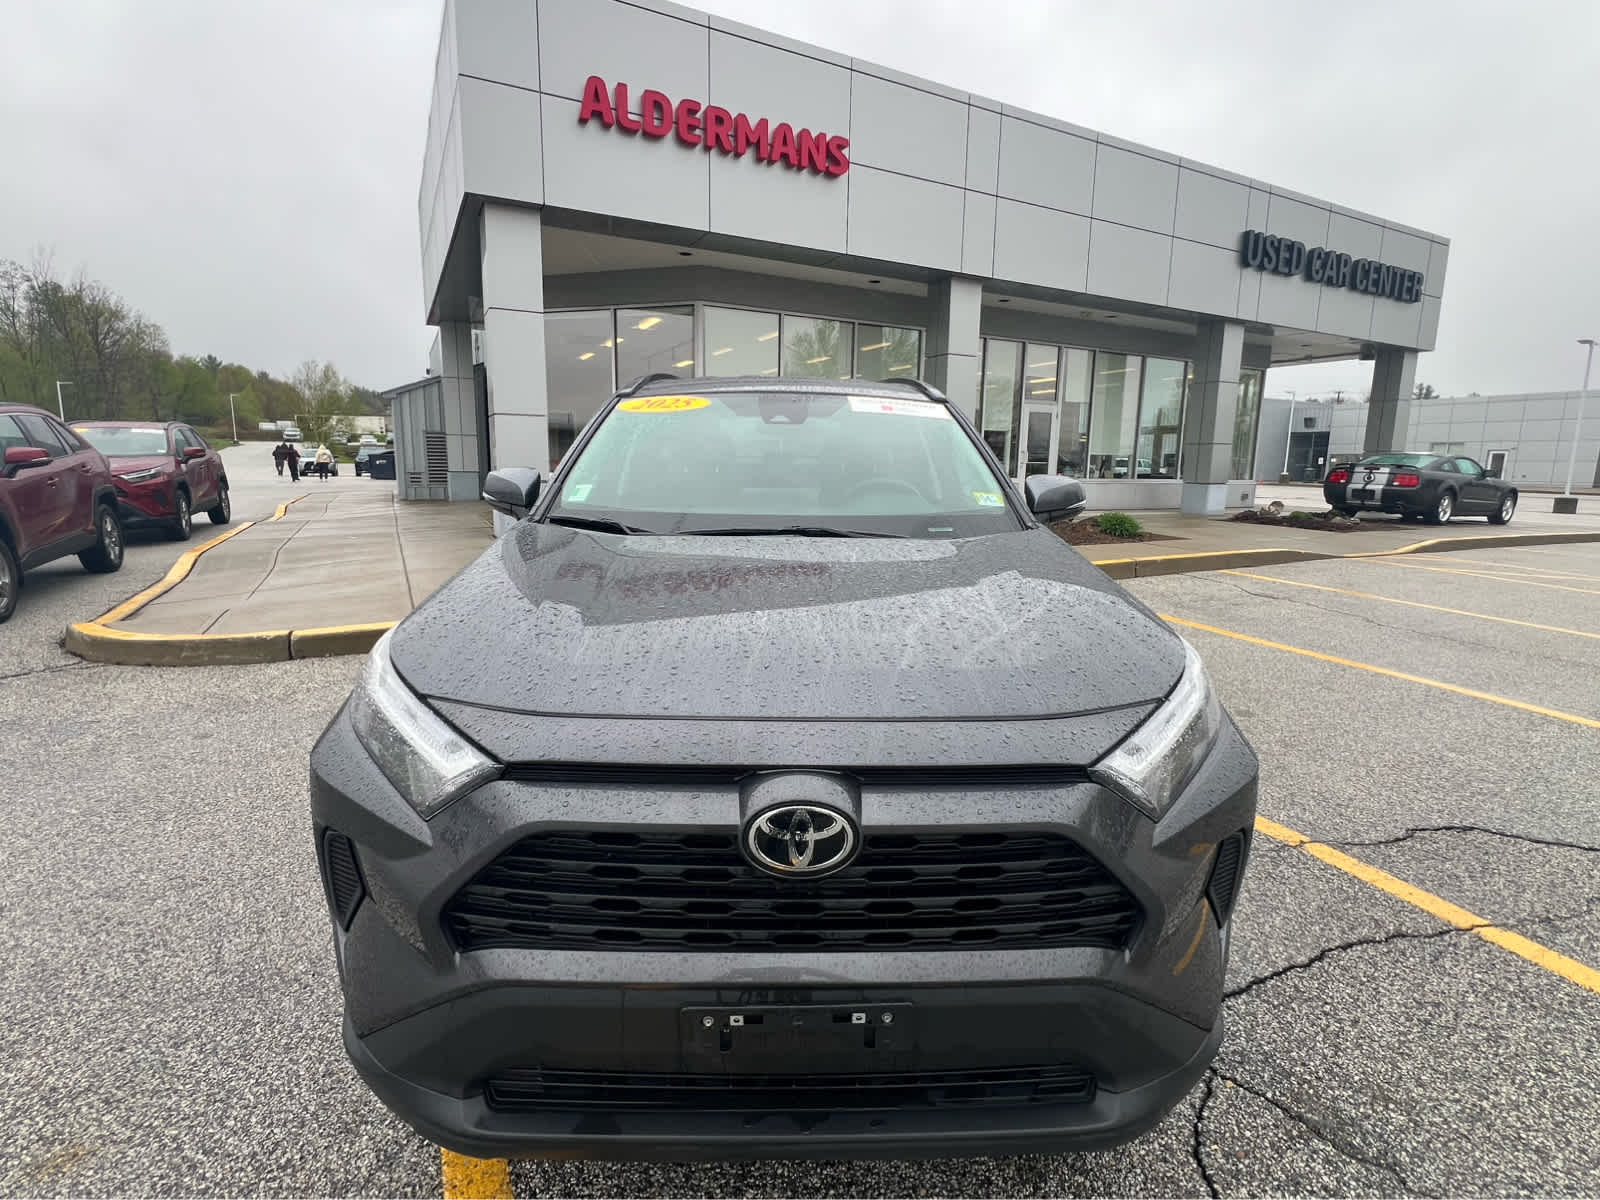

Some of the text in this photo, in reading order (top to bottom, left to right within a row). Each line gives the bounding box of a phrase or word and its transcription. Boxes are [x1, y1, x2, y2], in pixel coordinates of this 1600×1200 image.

[578, 75, 850, 177] ALDERMANS
[1242, 230, 1424, 304] USED CAR CENTER
